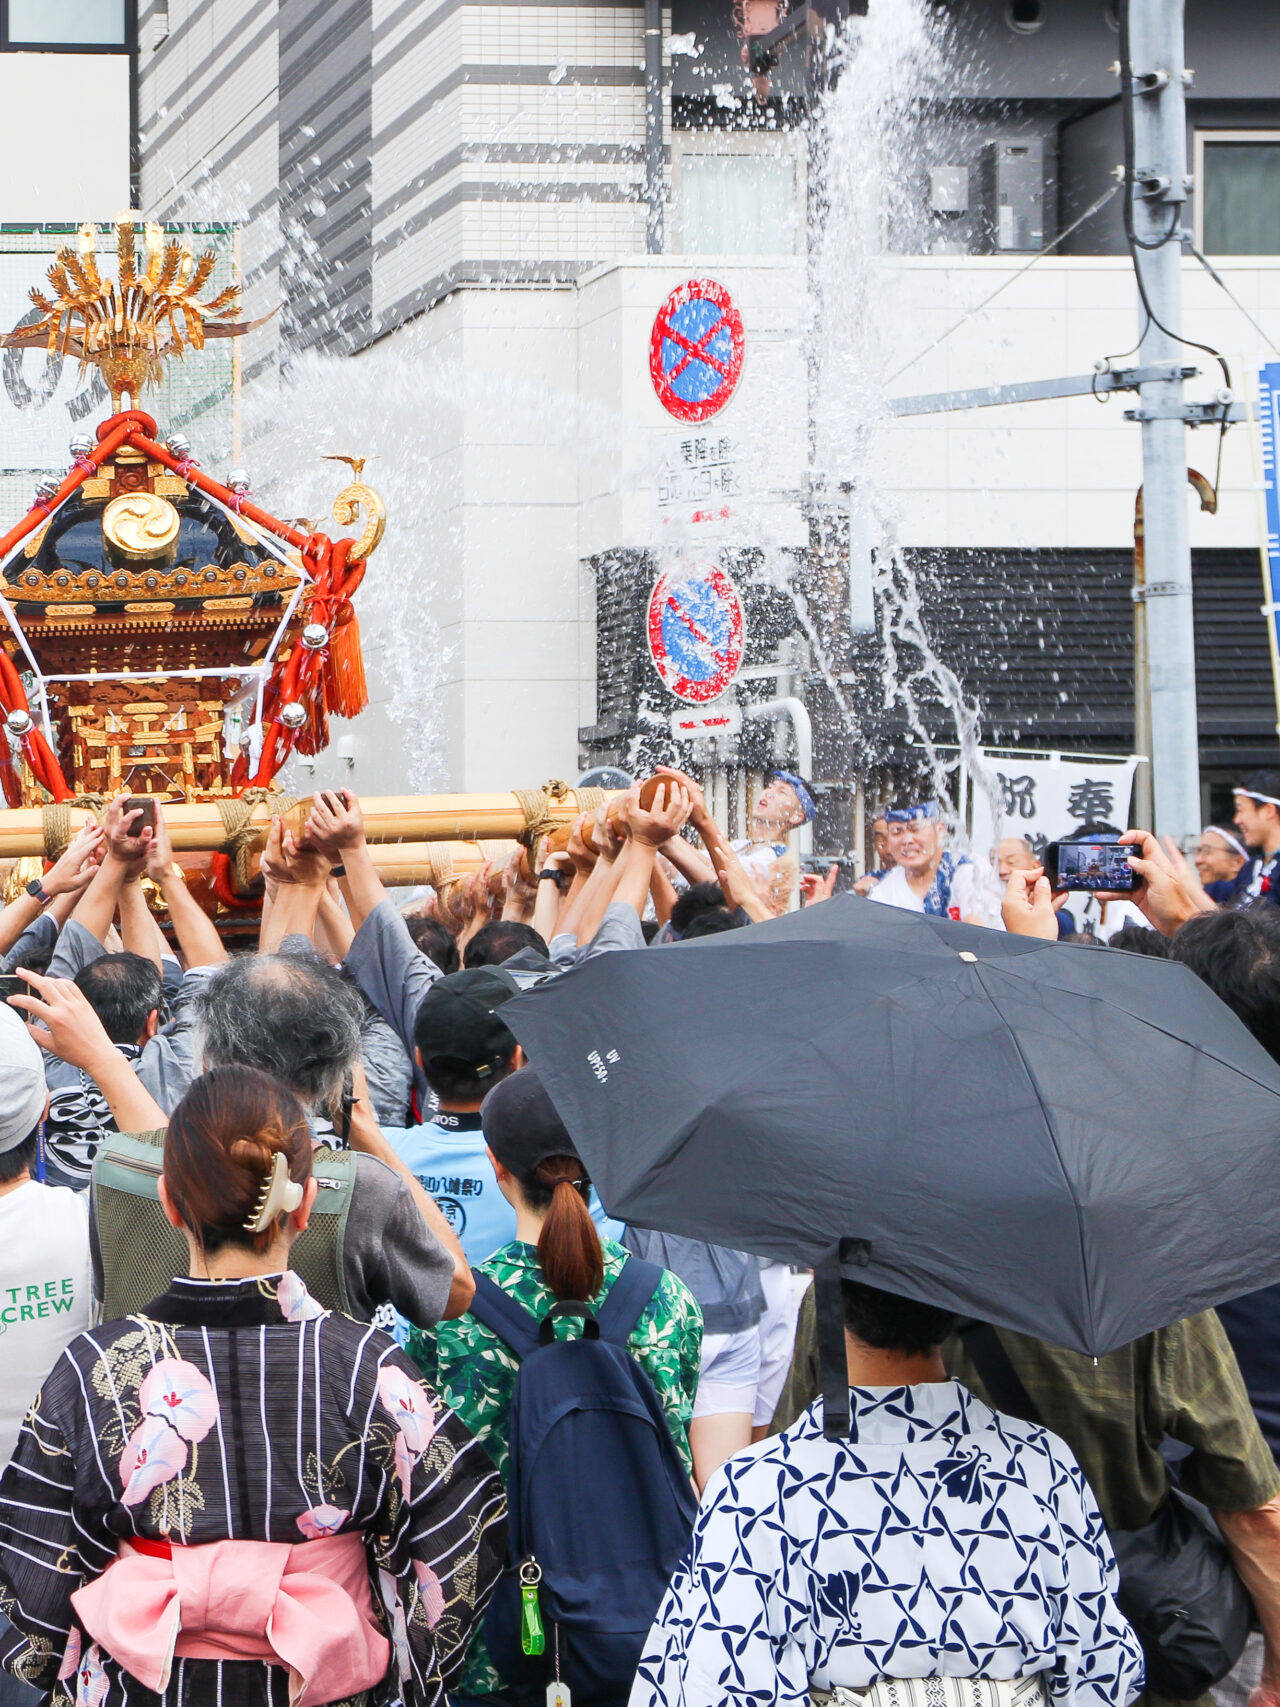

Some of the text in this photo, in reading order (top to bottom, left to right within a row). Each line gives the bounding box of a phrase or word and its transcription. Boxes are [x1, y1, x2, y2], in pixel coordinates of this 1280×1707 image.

[587, 1050, 608, 1084] UPF50+
[606, 1048, 621, 1064] UV
[5, 1278, 74, 1304] TREE
[1, 1296, 75, 1324] CREW
